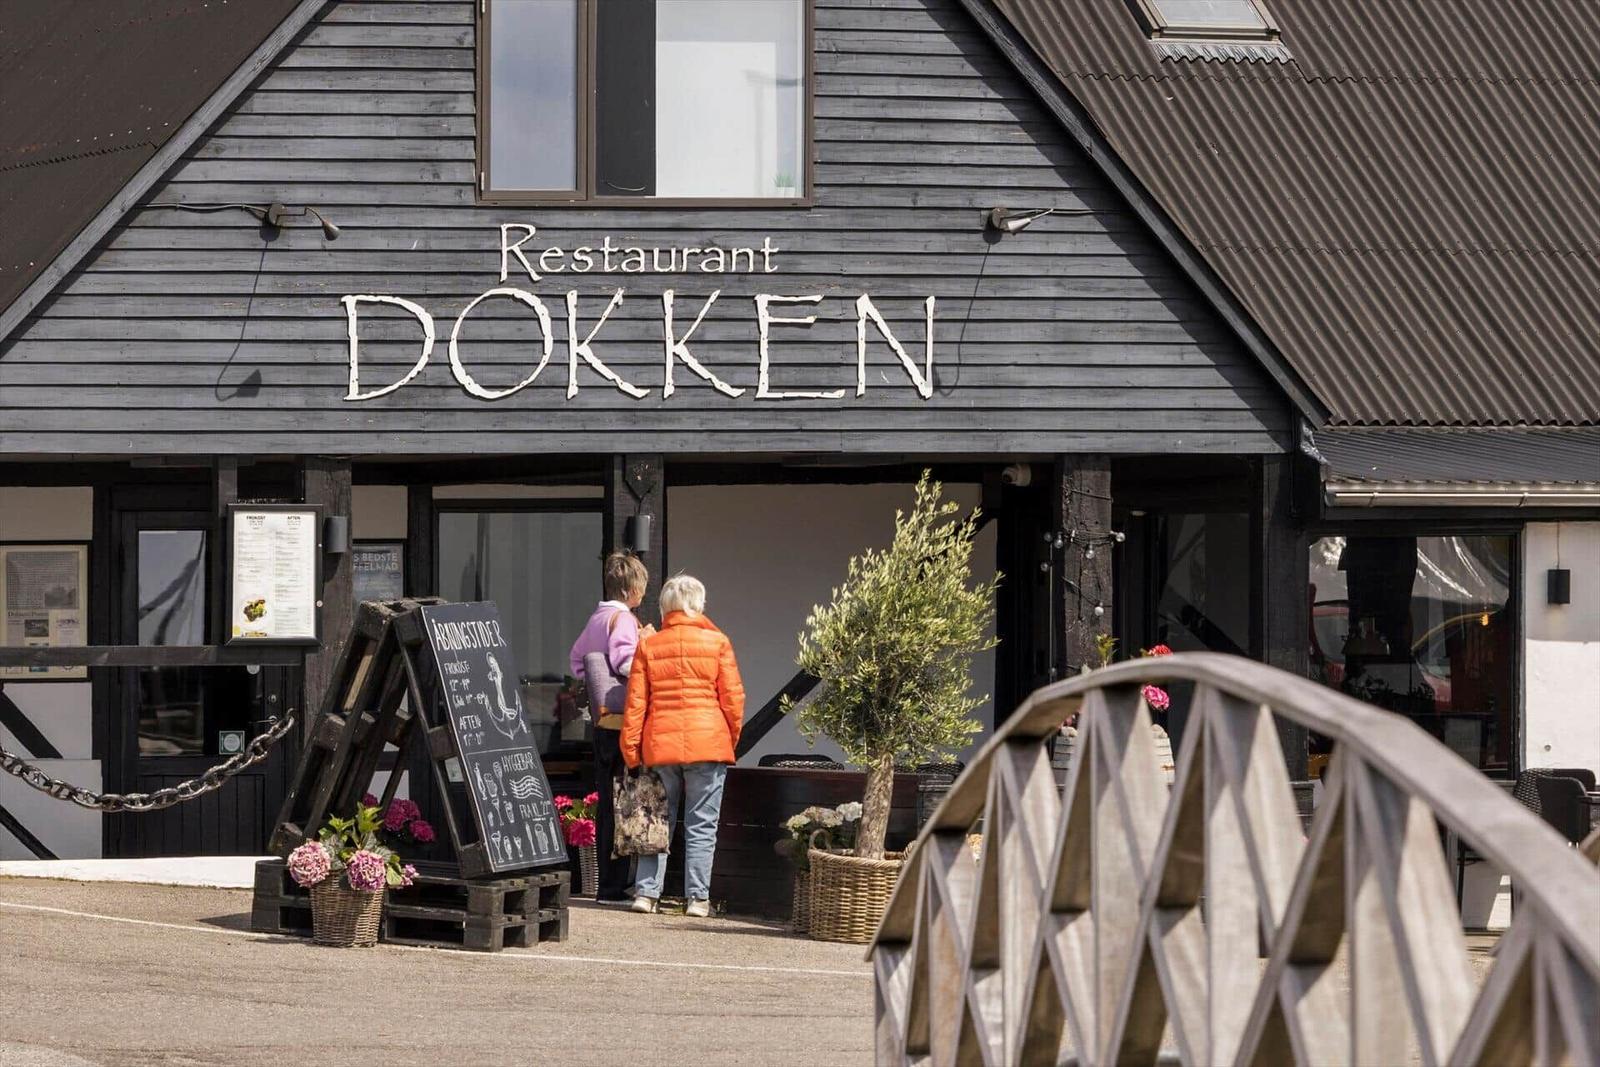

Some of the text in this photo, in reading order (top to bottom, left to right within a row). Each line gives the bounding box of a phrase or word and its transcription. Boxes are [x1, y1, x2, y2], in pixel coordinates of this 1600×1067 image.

[499, 222, 780, 283] Restaurant
[341, 287, 935, 401] DOKKEN
[362, 553, 398, 562] BEDSTE
